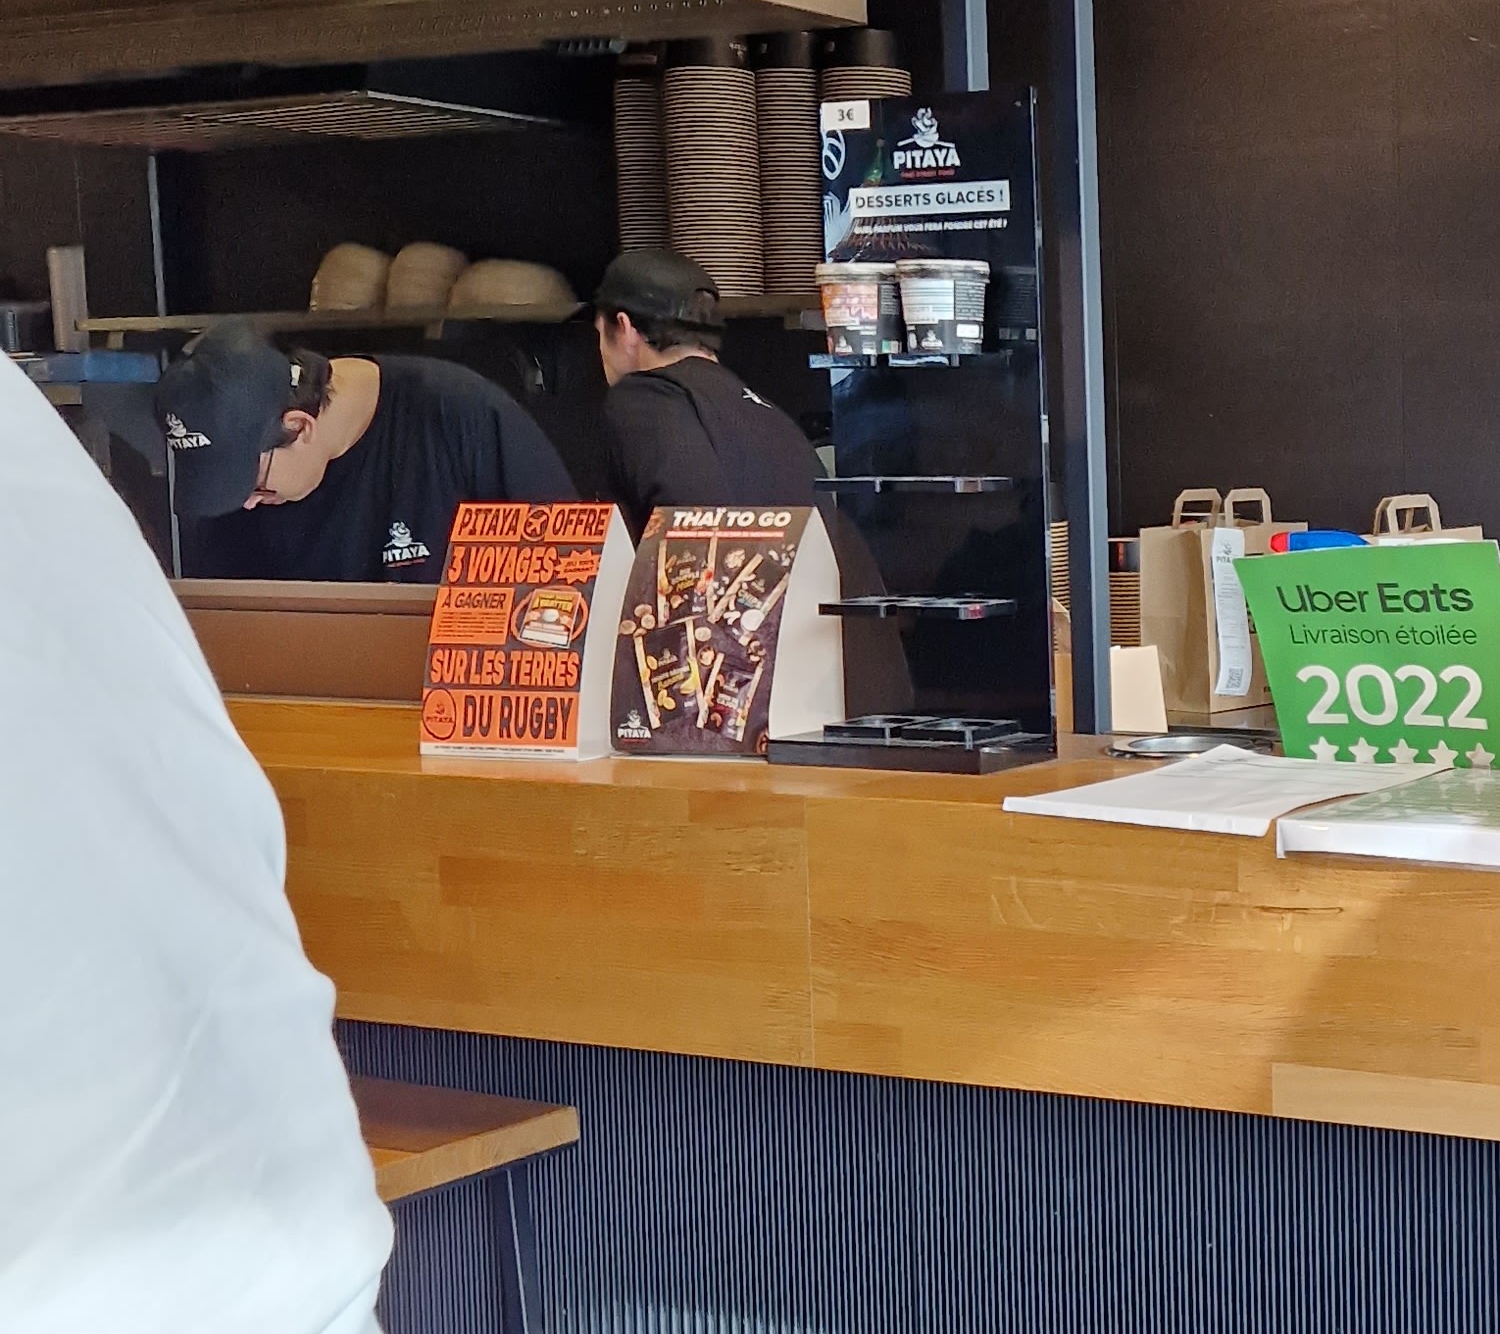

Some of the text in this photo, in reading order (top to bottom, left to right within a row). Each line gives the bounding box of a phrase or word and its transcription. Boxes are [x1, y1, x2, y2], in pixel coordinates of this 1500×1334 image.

[893, 148, 961, 169] PITAYA
[855, 193, 931, 209] DESSERTS
[935, 185, 995, 205] GLACÉS
[457, 508, 610, 537] PITAYA OFFRE
[673, 507, 792, 527] THAÏ TO GO
[447, 545, 559, 584] 3 VOYAGES
[442, 587, 507, 610] À GAGNER
[1276, 582, 1474, 614] Uber Eats
[1289, 624, 1478, 646] Livraison étoilée
[430, 649, 579, 687] SUR LES TERRES
[1296, 664, 1489, 731] 2022
[462, 694, 574, 740] DU RUGBY
[617, 727, 652, 739] PITAYA
